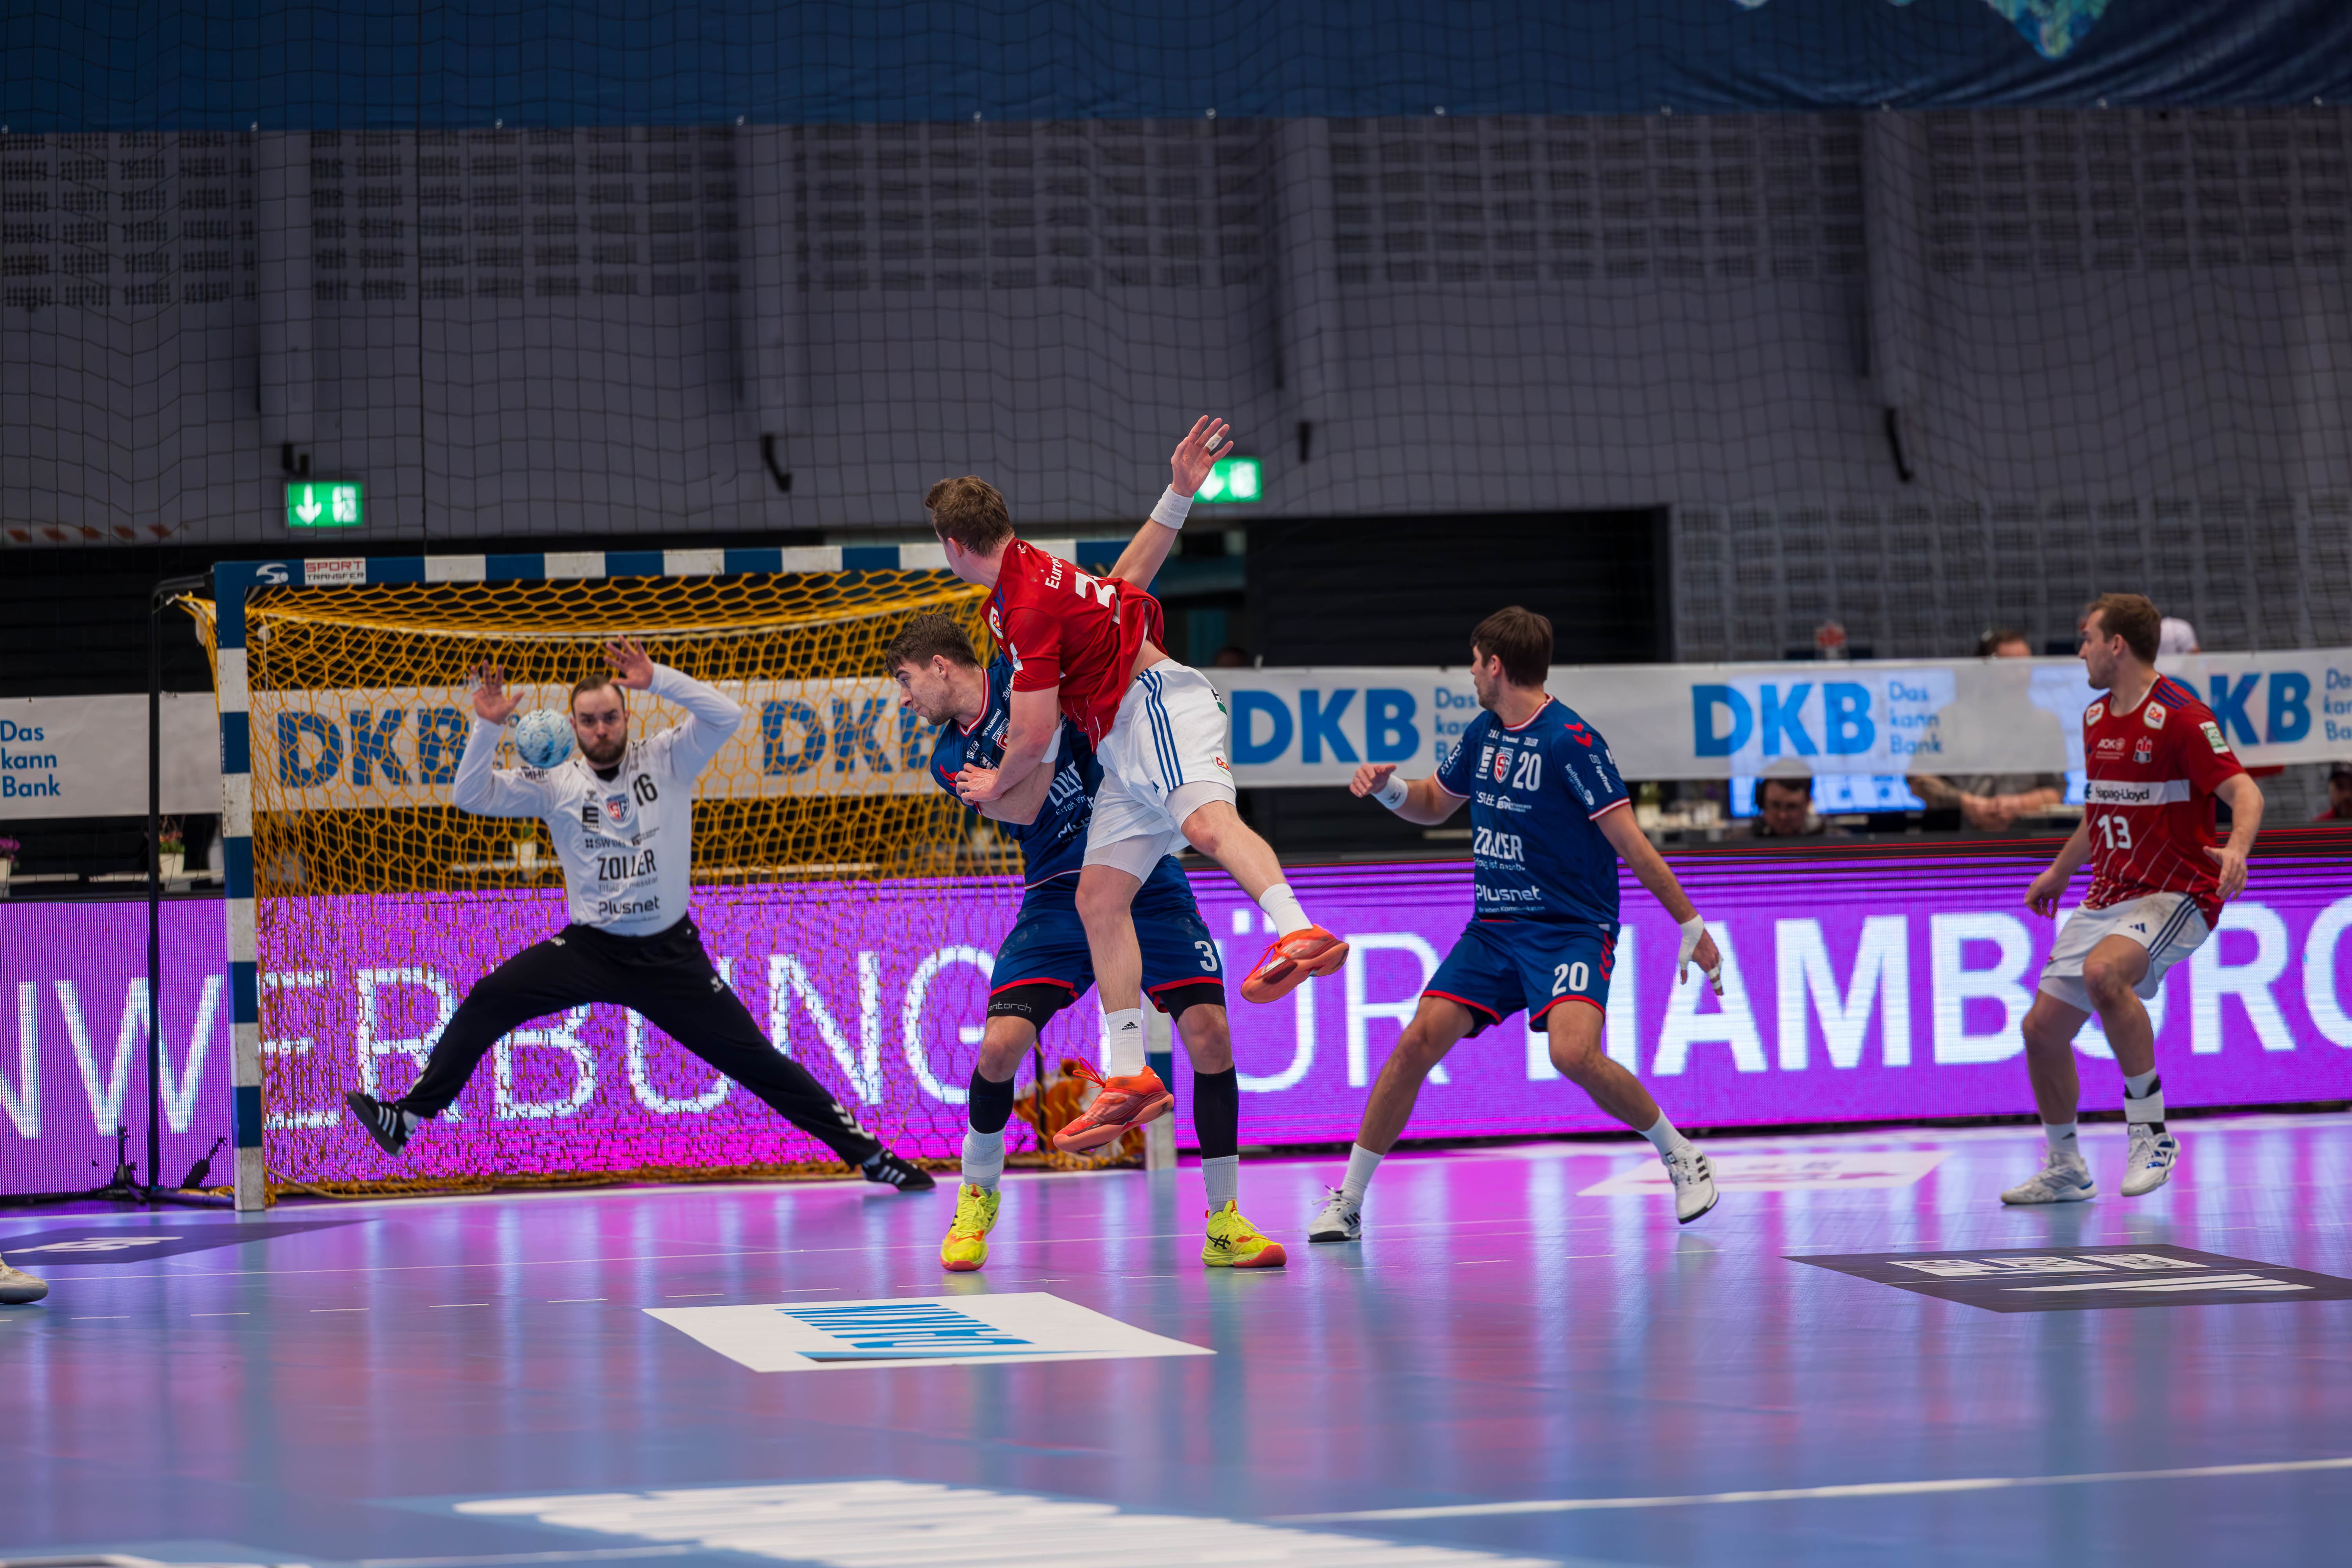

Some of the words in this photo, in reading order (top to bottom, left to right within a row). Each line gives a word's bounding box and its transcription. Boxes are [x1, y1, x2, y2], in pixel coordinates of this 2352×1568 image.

[305, 561, 364, 573] SPORT
[307, 572, 364, 581] TRANSFER
[1888, 682, 1928, 702] Das
[985, 708, 1002, 731] hummel
[1691, 682, 1876, 757] DKB
[1888, 708, 1940, 730] kann
[2167, 671, 2311, 747] KB
[0, 719, 44, 741] Das
[1231, 689, 1420, 764] DKB
[967, 740, 980, 759] ZOLLER
[1890, 734, 1943, 755] Bank
[1, 747, 57, 770] kann
[1512, 751, 1542, 791] 20
[2, 773, 61, 798] Bank
[633, 773, 658, 806] 16
[1474, 826, 1525, 862] ZOLLER
[2097, 814, 2132, 850] 13
[597, 849, 657, 881] ZOLLER
[1475, 884, 1542, 902] Plusnet
[599, 895, 660, 916] Plusnet
[1194, 940, 1218, 971] 3
[1552, 961, 1589, 997] 20
